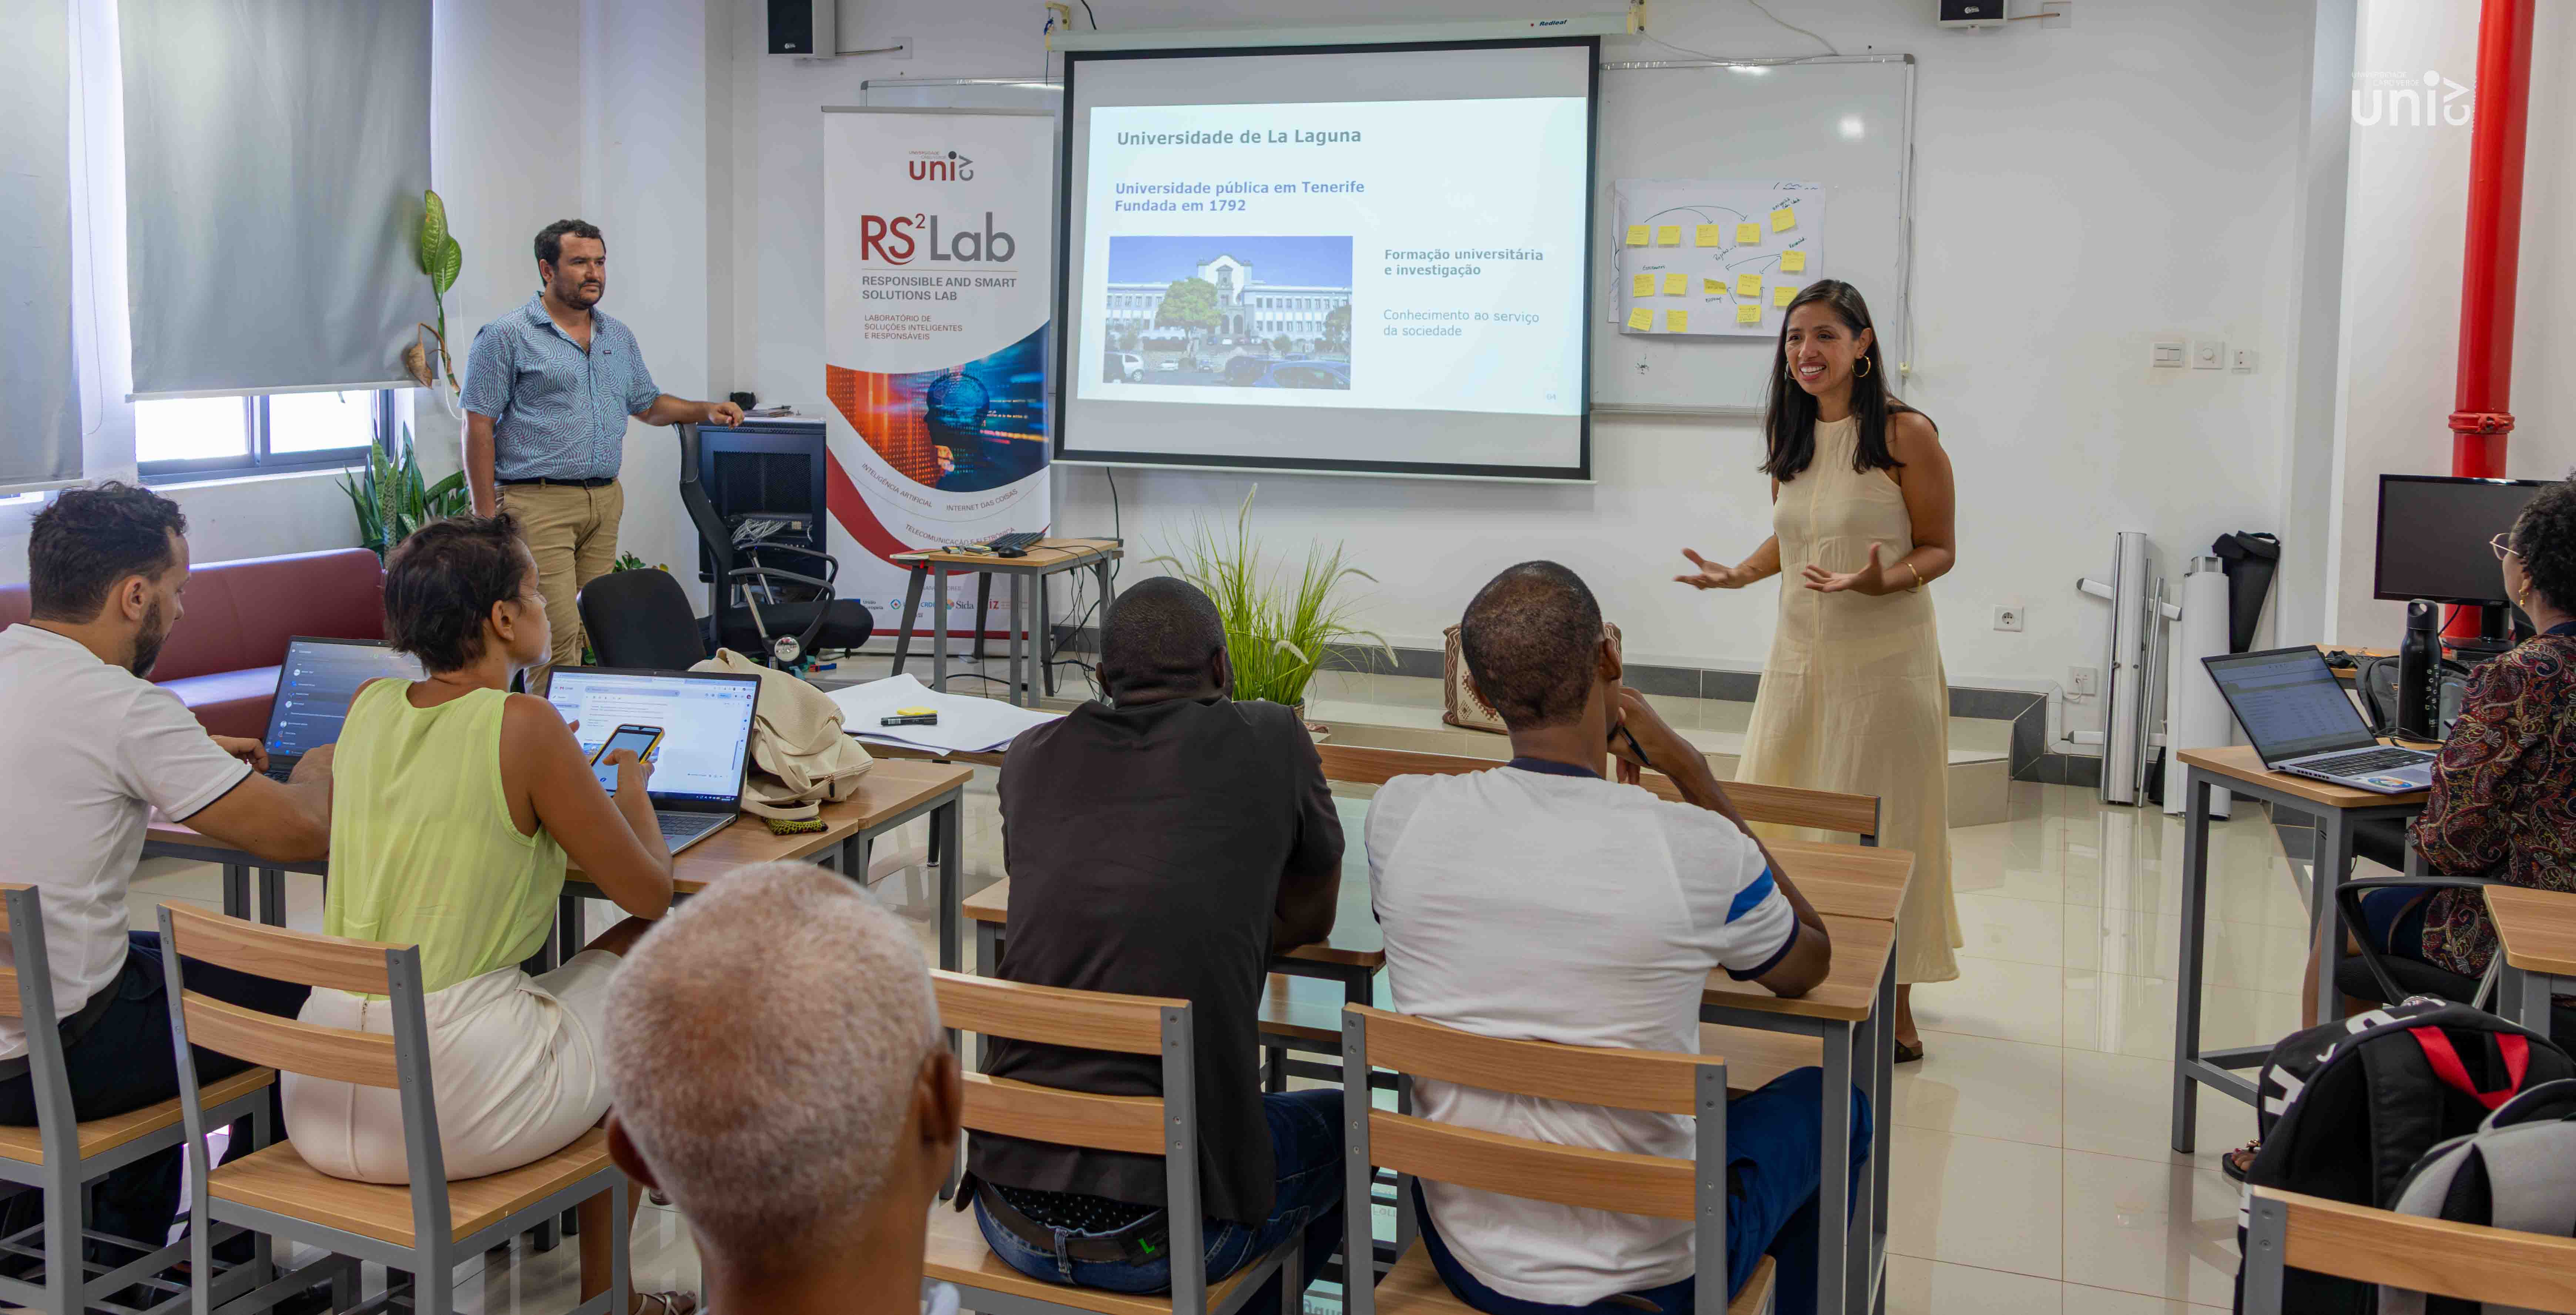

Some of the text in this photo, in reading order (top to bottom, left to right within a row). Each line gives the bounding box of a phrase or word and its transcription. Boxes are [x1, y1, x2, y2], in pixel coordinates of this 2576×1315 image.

[1118, 129, 1361, 146] Universidade de La Laguna
[1116, 181, 1365, 196] Universidade pública em Tenerife
[1115, 200, 1246, 211] Fundada em 1792
[1385, 248, 1543, 262] Formação universitária
[1385, 264, 1481, 278] e investigação
[862, 276, 1017, 288] RESPONSIBLE AND SMART
[862, 290, 957, 300] SOLUTIONS LAB
[865, 314, 919, 322] LABORATÓRIO
[1383, 309, 1539, 325] Conhecimento ao serviço
[865, 323, 906, 332] SOLUÇÕES
[1383, 325, 1462, 336] da sociedade
[862, 463, 932, 507] INTELIGÊNCIA ARTIFICIAL
[980, 500, 994, 509] DAS
[995, 488, 1018, 504] COISAS
[956, 600, 974, 609] Sida
